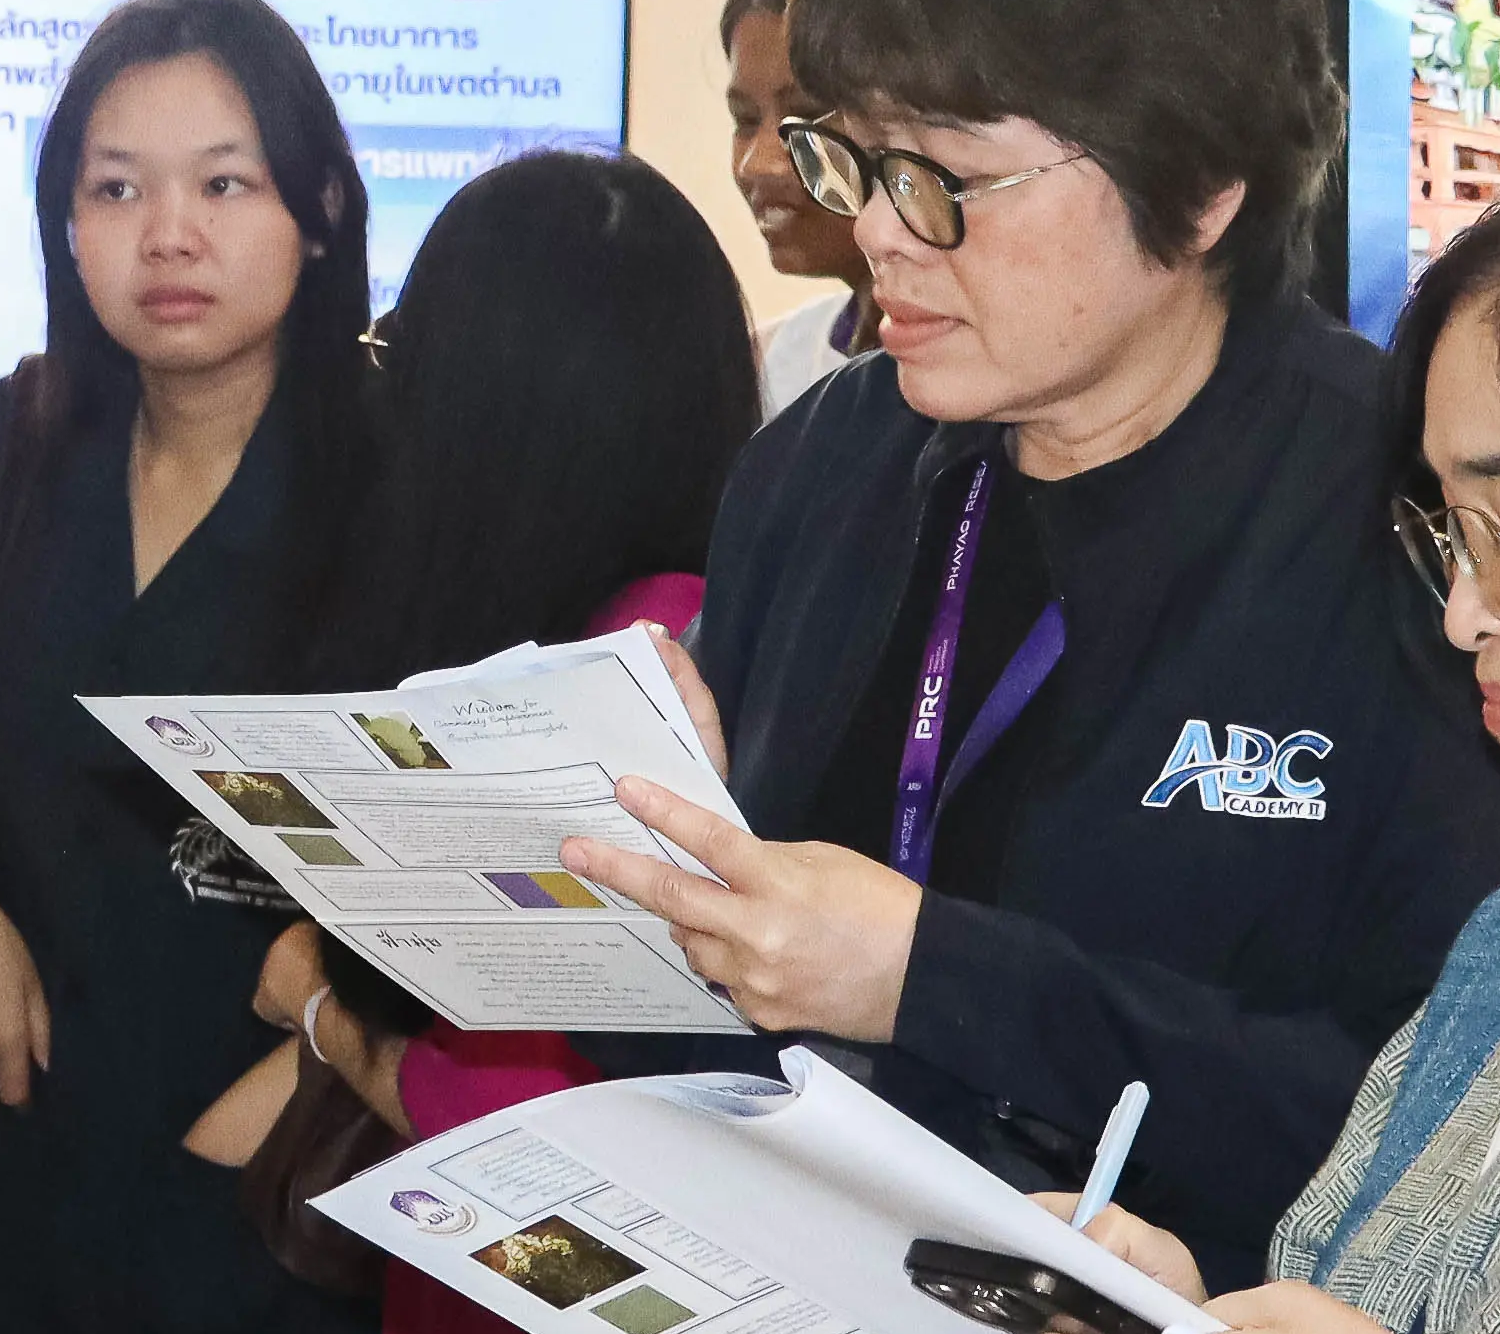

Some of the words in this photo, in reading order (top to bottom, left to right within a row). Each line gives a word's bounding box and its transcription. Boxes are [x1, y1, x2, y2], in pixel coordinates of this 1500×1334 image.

[945, 519, 971, 592] PHAYAO
[914, 675, 944, 741] PRC
[1140, 718, 1335, 812] ABC
